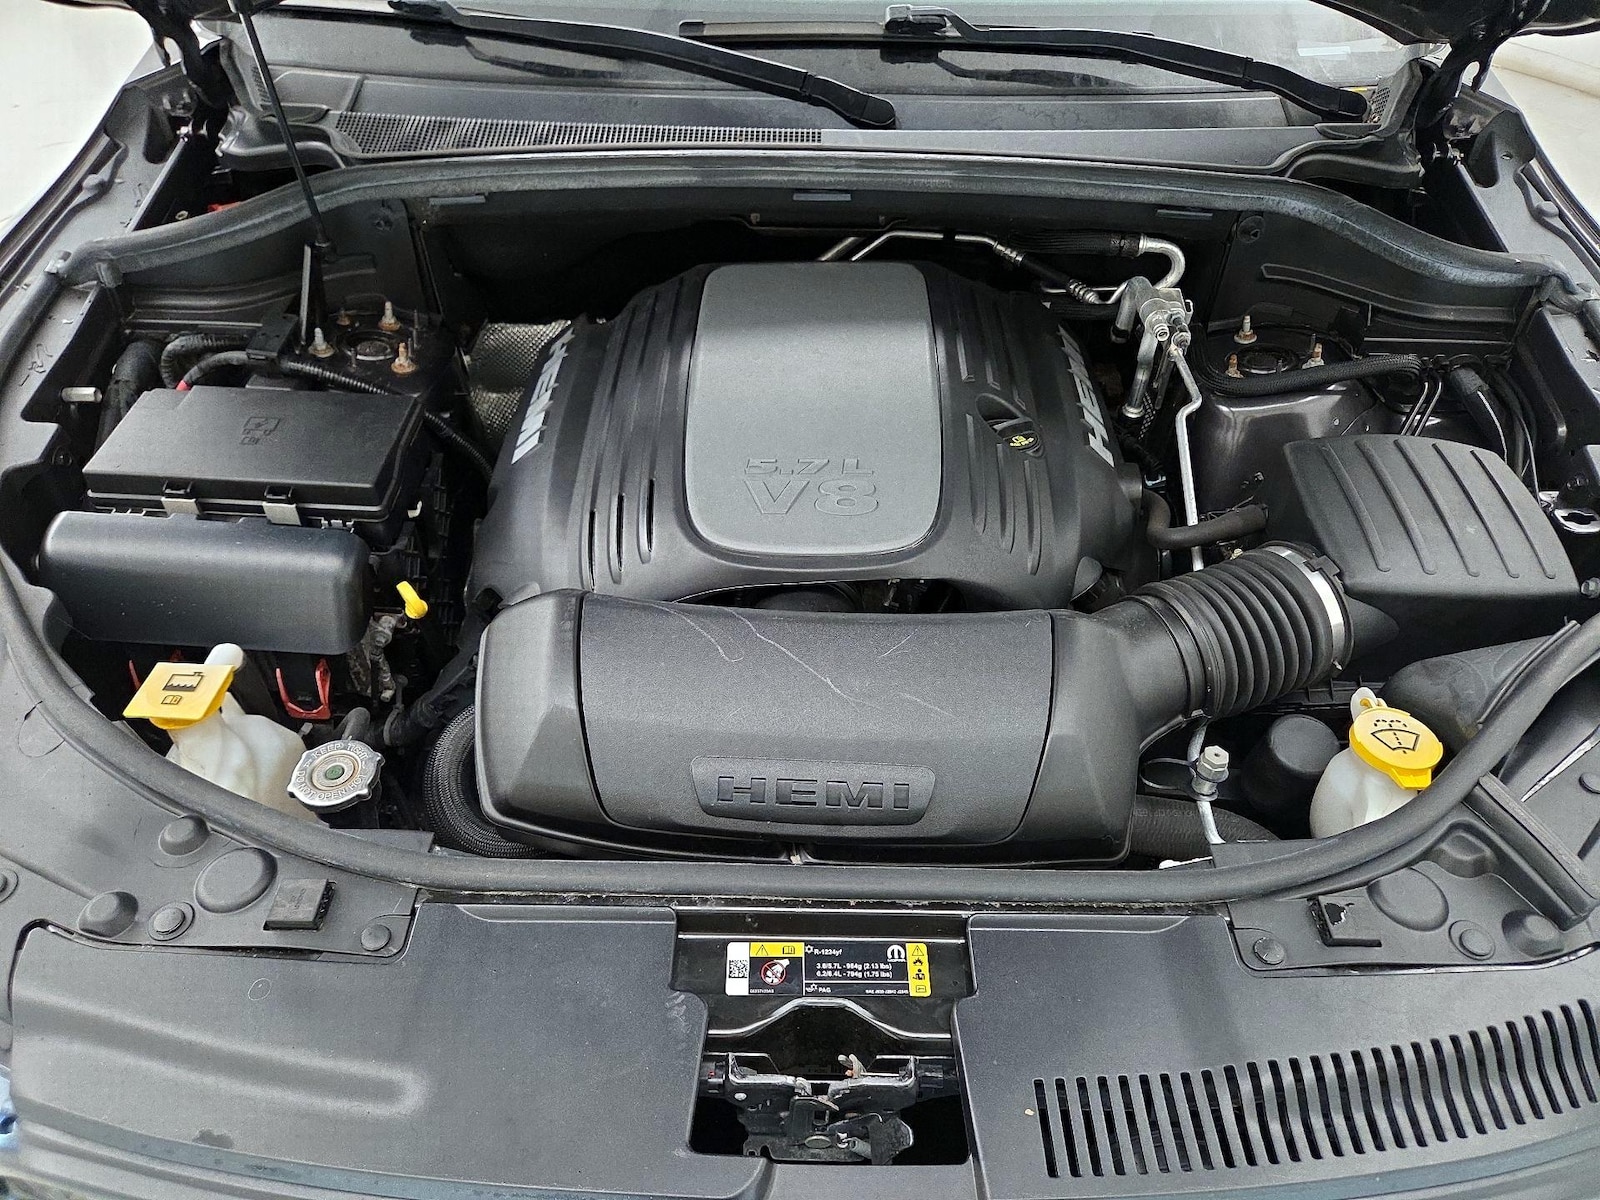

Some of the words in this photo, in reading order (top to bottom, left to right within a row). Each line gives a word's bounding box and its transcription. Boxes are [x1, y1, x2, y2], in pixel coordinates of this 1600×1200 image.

[511, 327, 574, 465] HEMI
[1057, 324, 1115, 468] HEMI
[744, 480, 879, 517] V8
[312, 743, 344, 759] KEEP
[346, 743, 369, 760] TIGHT
[296, 770, 306, 783] DO
[349, 774, 366, 791] HOT
[297, 782, 316, 798] NOT
[318, 788, 347, 800] OPEN
[717, 775, 910, 810] HEMI
[863, 962, 879, 971] (2.13
[880, 962, 893, 971] lbs)
[863, 970, 880, 979] (1.75
[880, 971, 893, 979] lbs)
